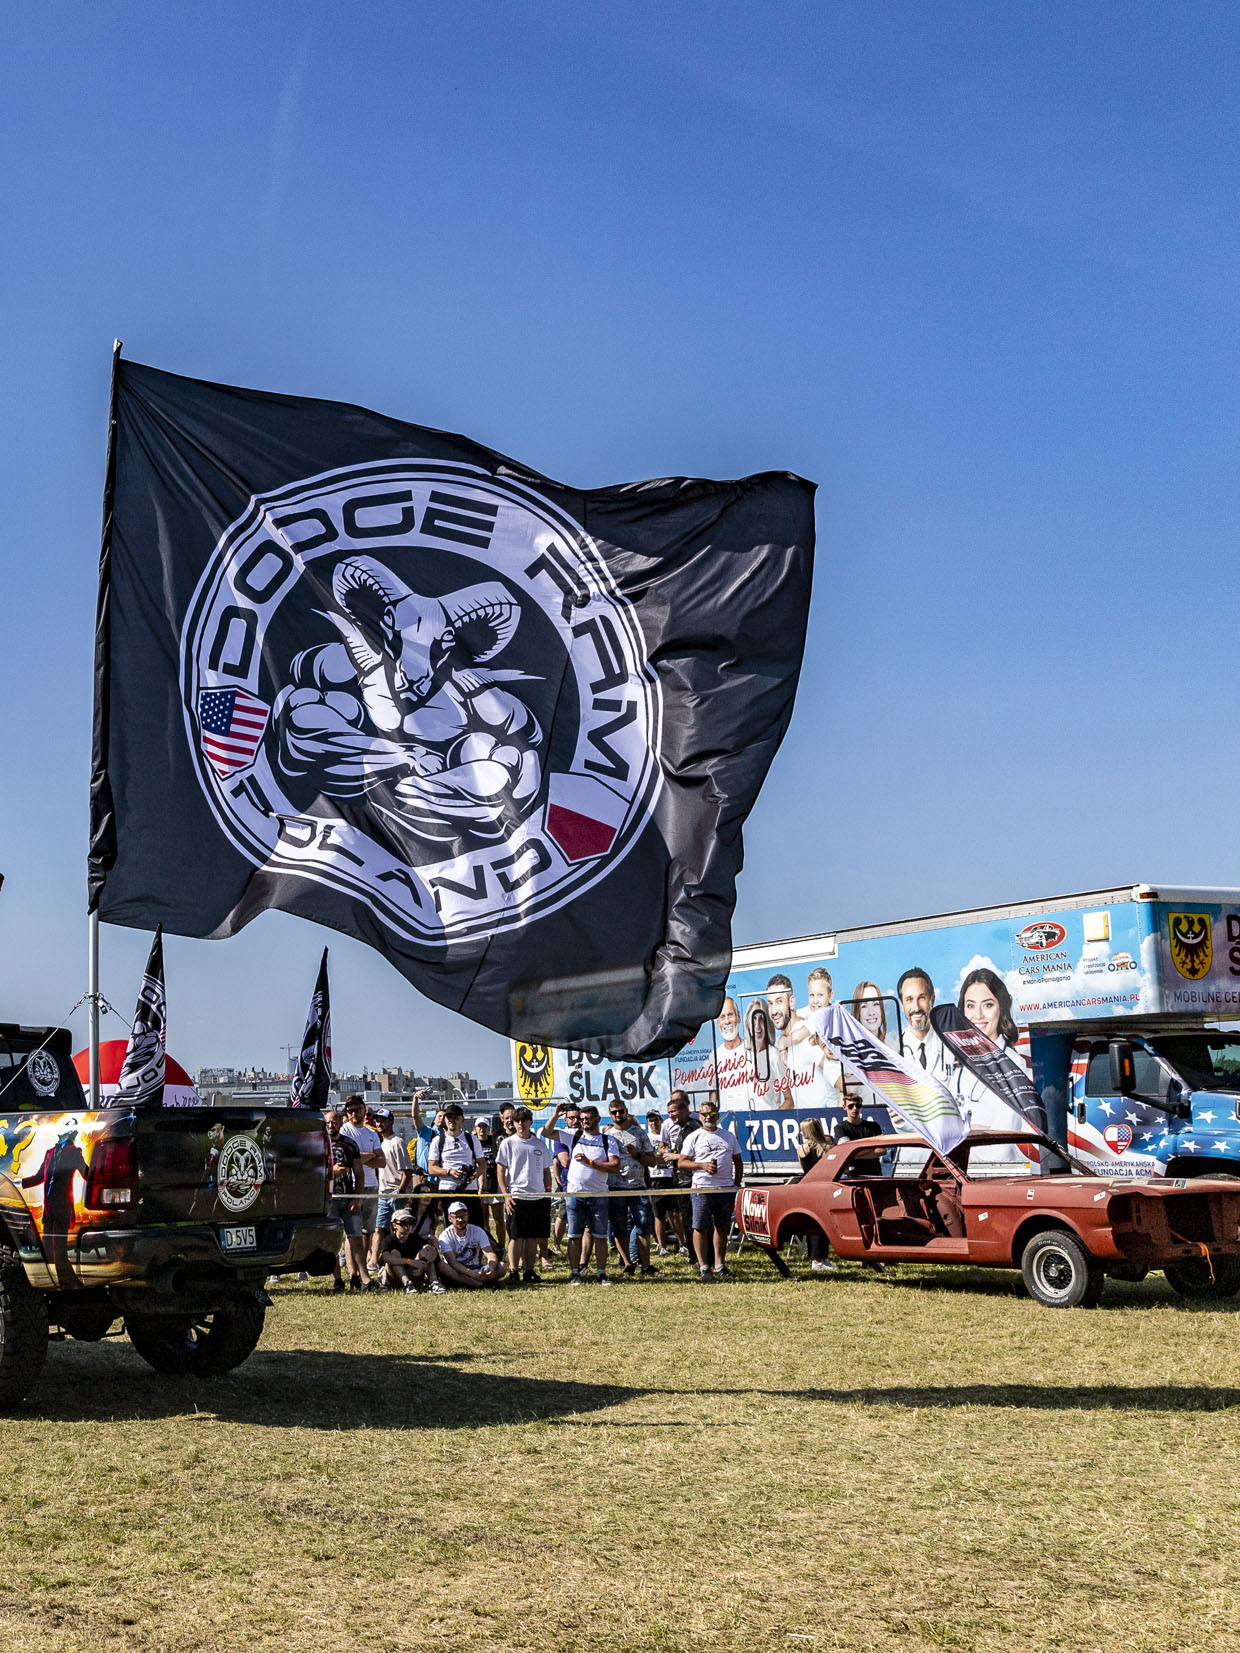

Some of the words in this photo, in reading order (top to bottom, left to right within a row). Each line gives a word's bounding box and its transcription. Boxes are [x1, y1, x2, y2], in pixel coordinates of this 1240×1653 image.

[209, 490, 499, 679] DODGE
[524, 542, 638, 782] RAM
[230, 774, 552, 914] POLAND
[1022, 951, 1067, 964] AMERICAN
[1018, 965, 1040, 975] CARS
[1042, 962, 1073, 973] MANIA
[1019, 993, 1141, 1012] WWW.AMERICANCARSMANIA.PL
[1174, 990, 1221, 1003] MOBILNE
[1224, 991, 1240, 1003] CE
[673, 1052, 747, 1087] Pomaganie
[221, 1140, 247, 1180] DODGE
[249, 1146, 264, 1179] RAM
[1093, 1168, 1134, 1177] FUNDACJA
[1135, 1168, 1153, 1177] ACM
[221, 1189, 256, 1207] POLAND
[744, 1215, 769, 1235] Silnik
[226, 1230, 233, 1247] D
[235, 1228, 255, 1246] 5V5
